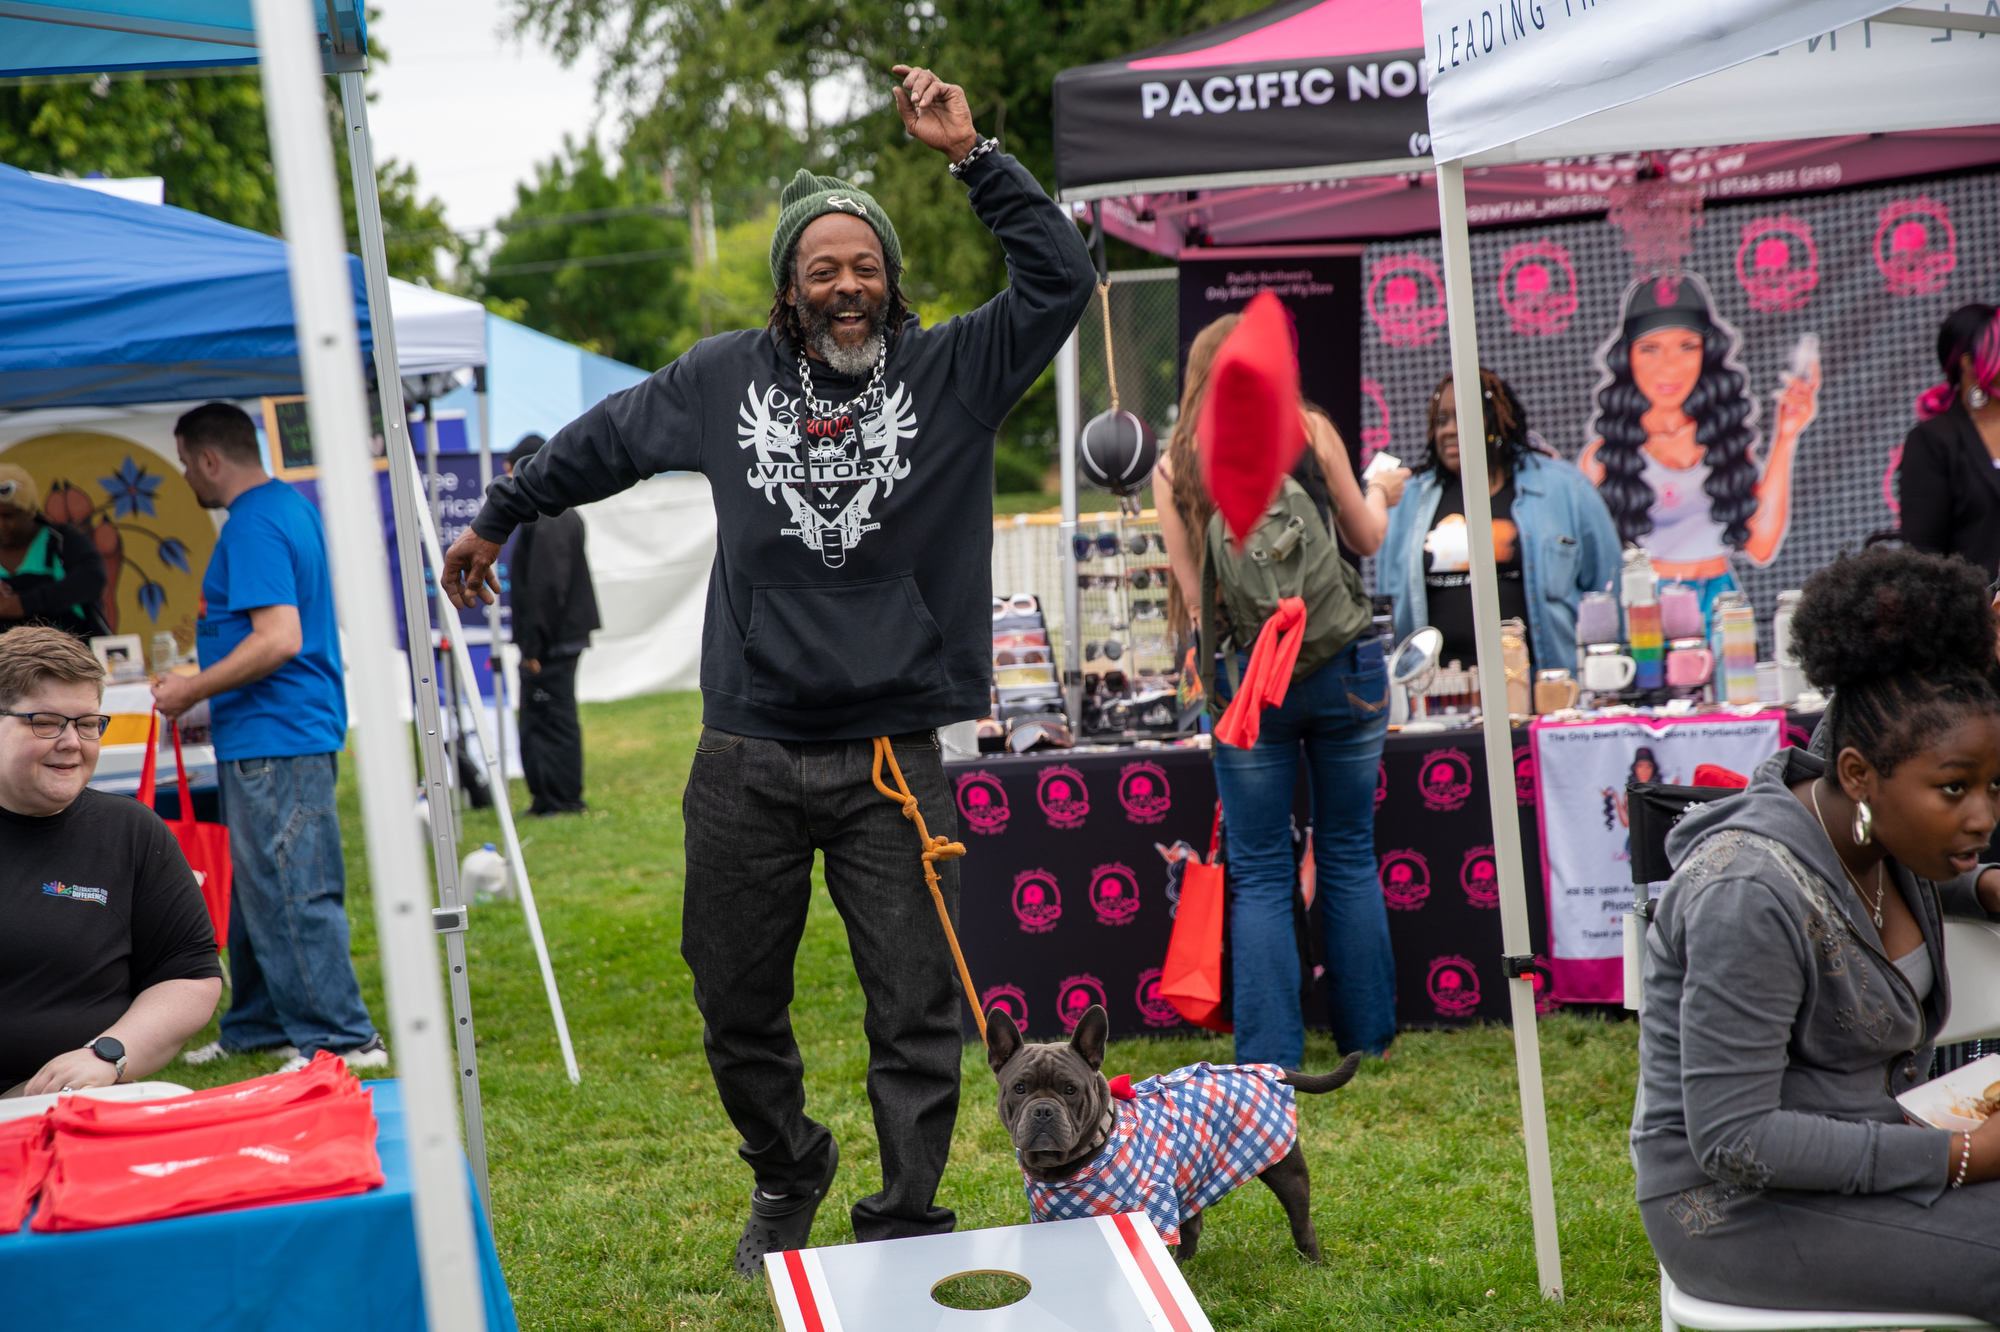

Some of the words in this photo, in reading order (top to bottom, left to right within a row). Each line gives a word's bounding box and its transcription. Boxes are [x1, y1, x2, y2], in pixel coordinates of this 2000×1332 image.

[1438, 0, 1545, 73] LEADING
[1141, 67, 1335, 119] PACIFIC
[1206, 287, 1229, 302] Only
[760, 457, 894, 480] VICTORY
[788, 479, 869, 488] MOORCYCLES
[1548, 732, 1566, 742] The
[1570, 731, 1590, 743] Only
[72, 890, 107, 904] DIFFERENCES
